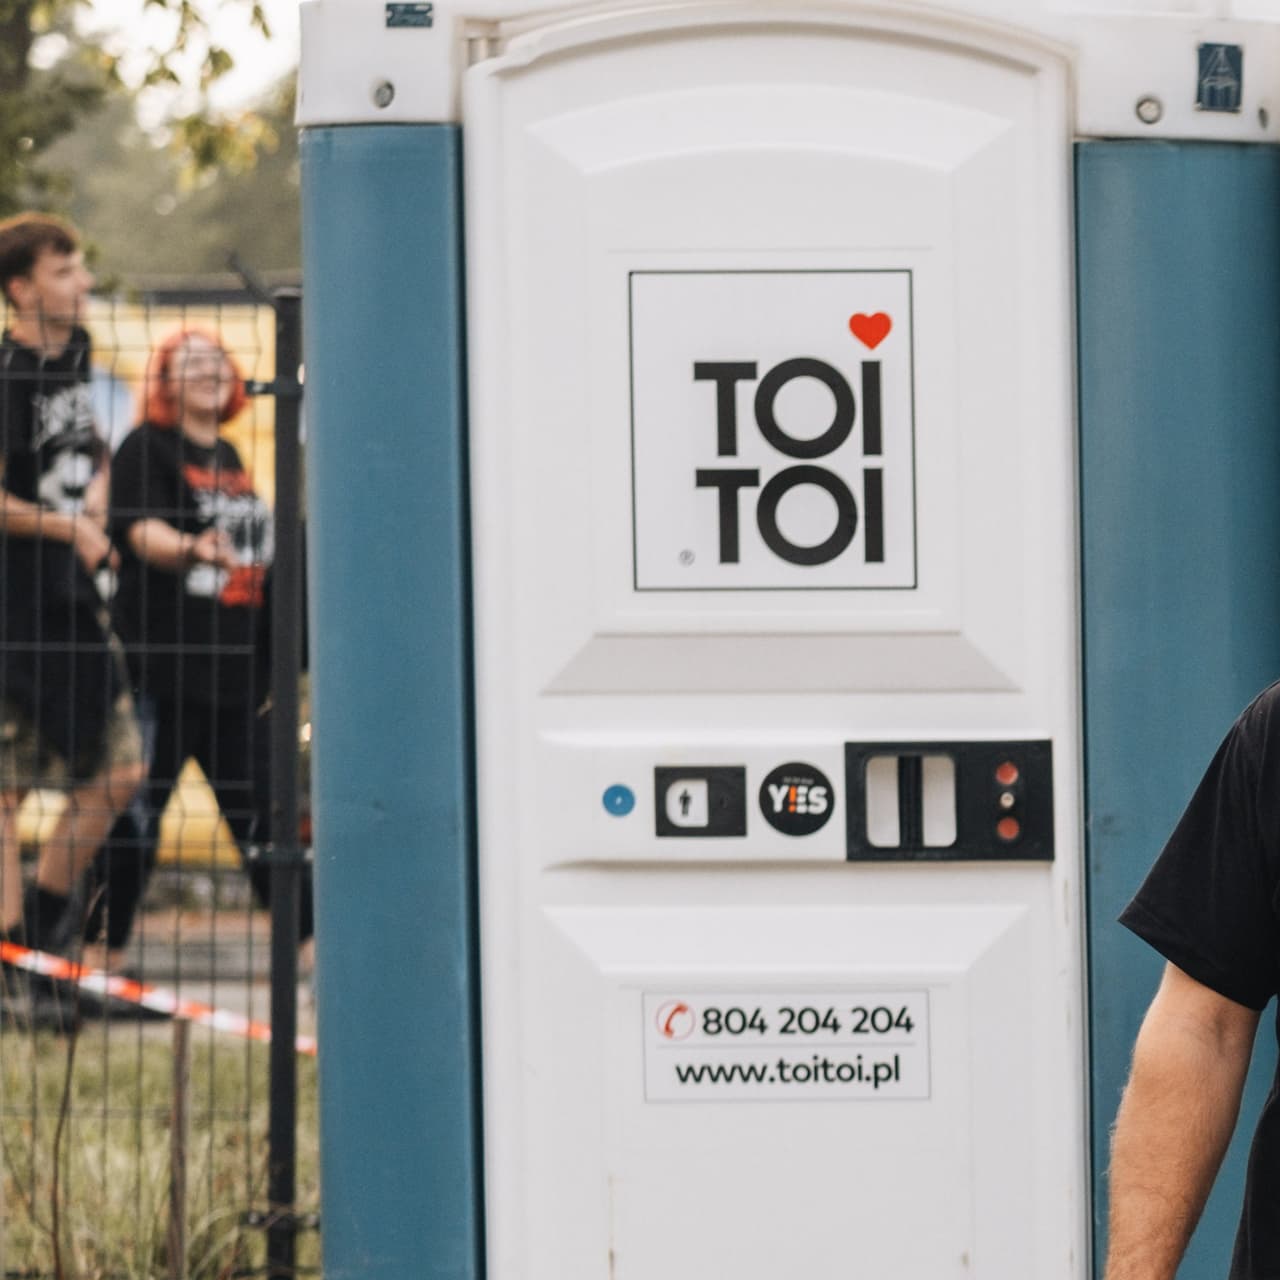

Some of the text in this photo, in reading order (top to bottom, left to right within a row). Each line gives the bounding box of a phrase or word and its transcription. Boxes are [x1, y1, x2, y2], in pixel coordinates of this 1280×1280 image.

[694, 357, 883, 460] TOI
[696, 464, 885, 567] TOI
[702, 1006, 914, 1035] 804 204 204
[675, 1054, 901, 1090] www.toitoi.pl
